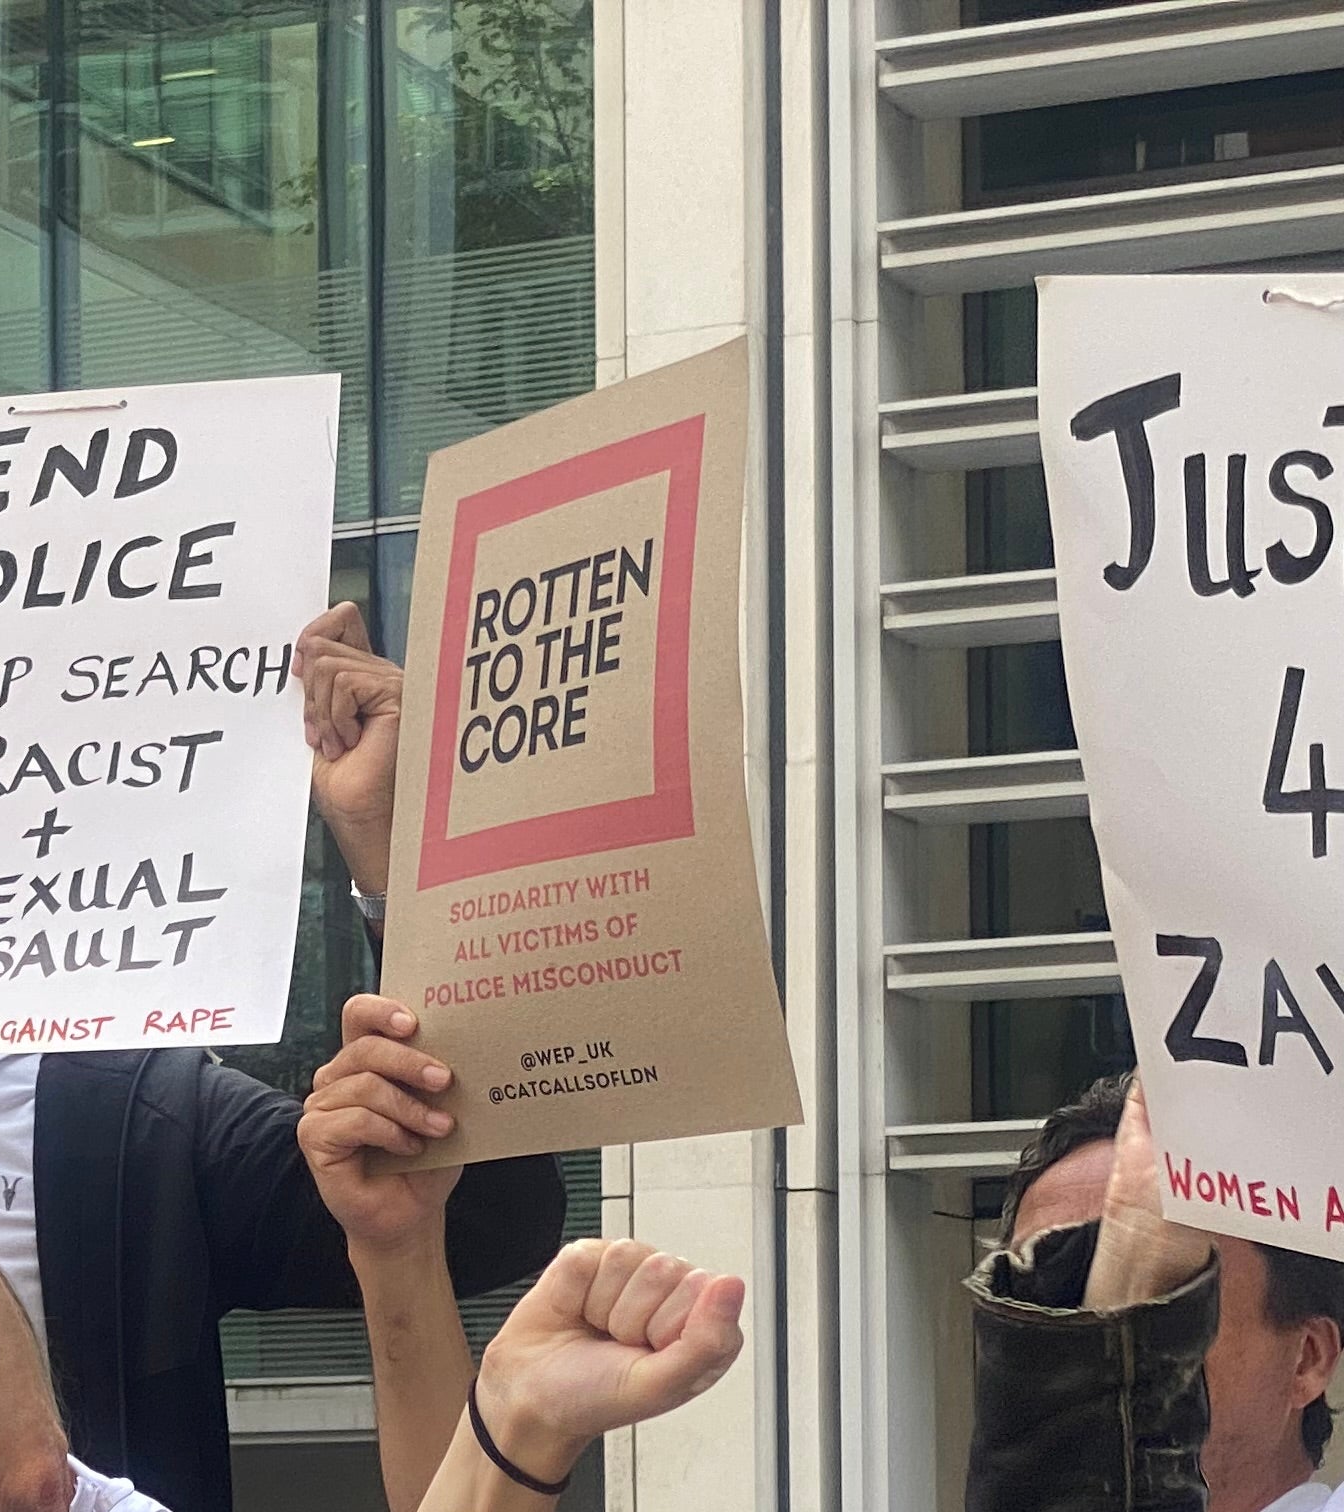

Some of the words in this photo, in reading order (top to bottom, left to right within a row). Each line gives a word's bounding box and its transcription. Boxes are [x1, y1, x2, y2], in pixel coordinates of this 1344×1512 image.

[470, 538, 654, 648] ROTTEN
[61, 643, 293, 703] SEARCH
[466, 643, 523, 710] TO
[536, 611, 622, 690] THE
[459, 685, 589, 774] CORE
[449, 879, 580, 924] SOLIDARITY
[586, 868, 650, 899] WITH
[454, 935, 491, 963] ALL
[498, 920, 598, 957] VICTIMS
[606, 913, 638, 940] OF
[424, 975, 505, 1008] POLICE
[513, 949, 683, 995] MISCONDUCT
[143, 1007, 236, 1035] RAPE
[489, 1066, 658, 1105] @CATCALLSOFLDN
[520, 1041, 614, 1071] @WEP_UK
[1165, 1153, 1300, 1221] WOMEN
